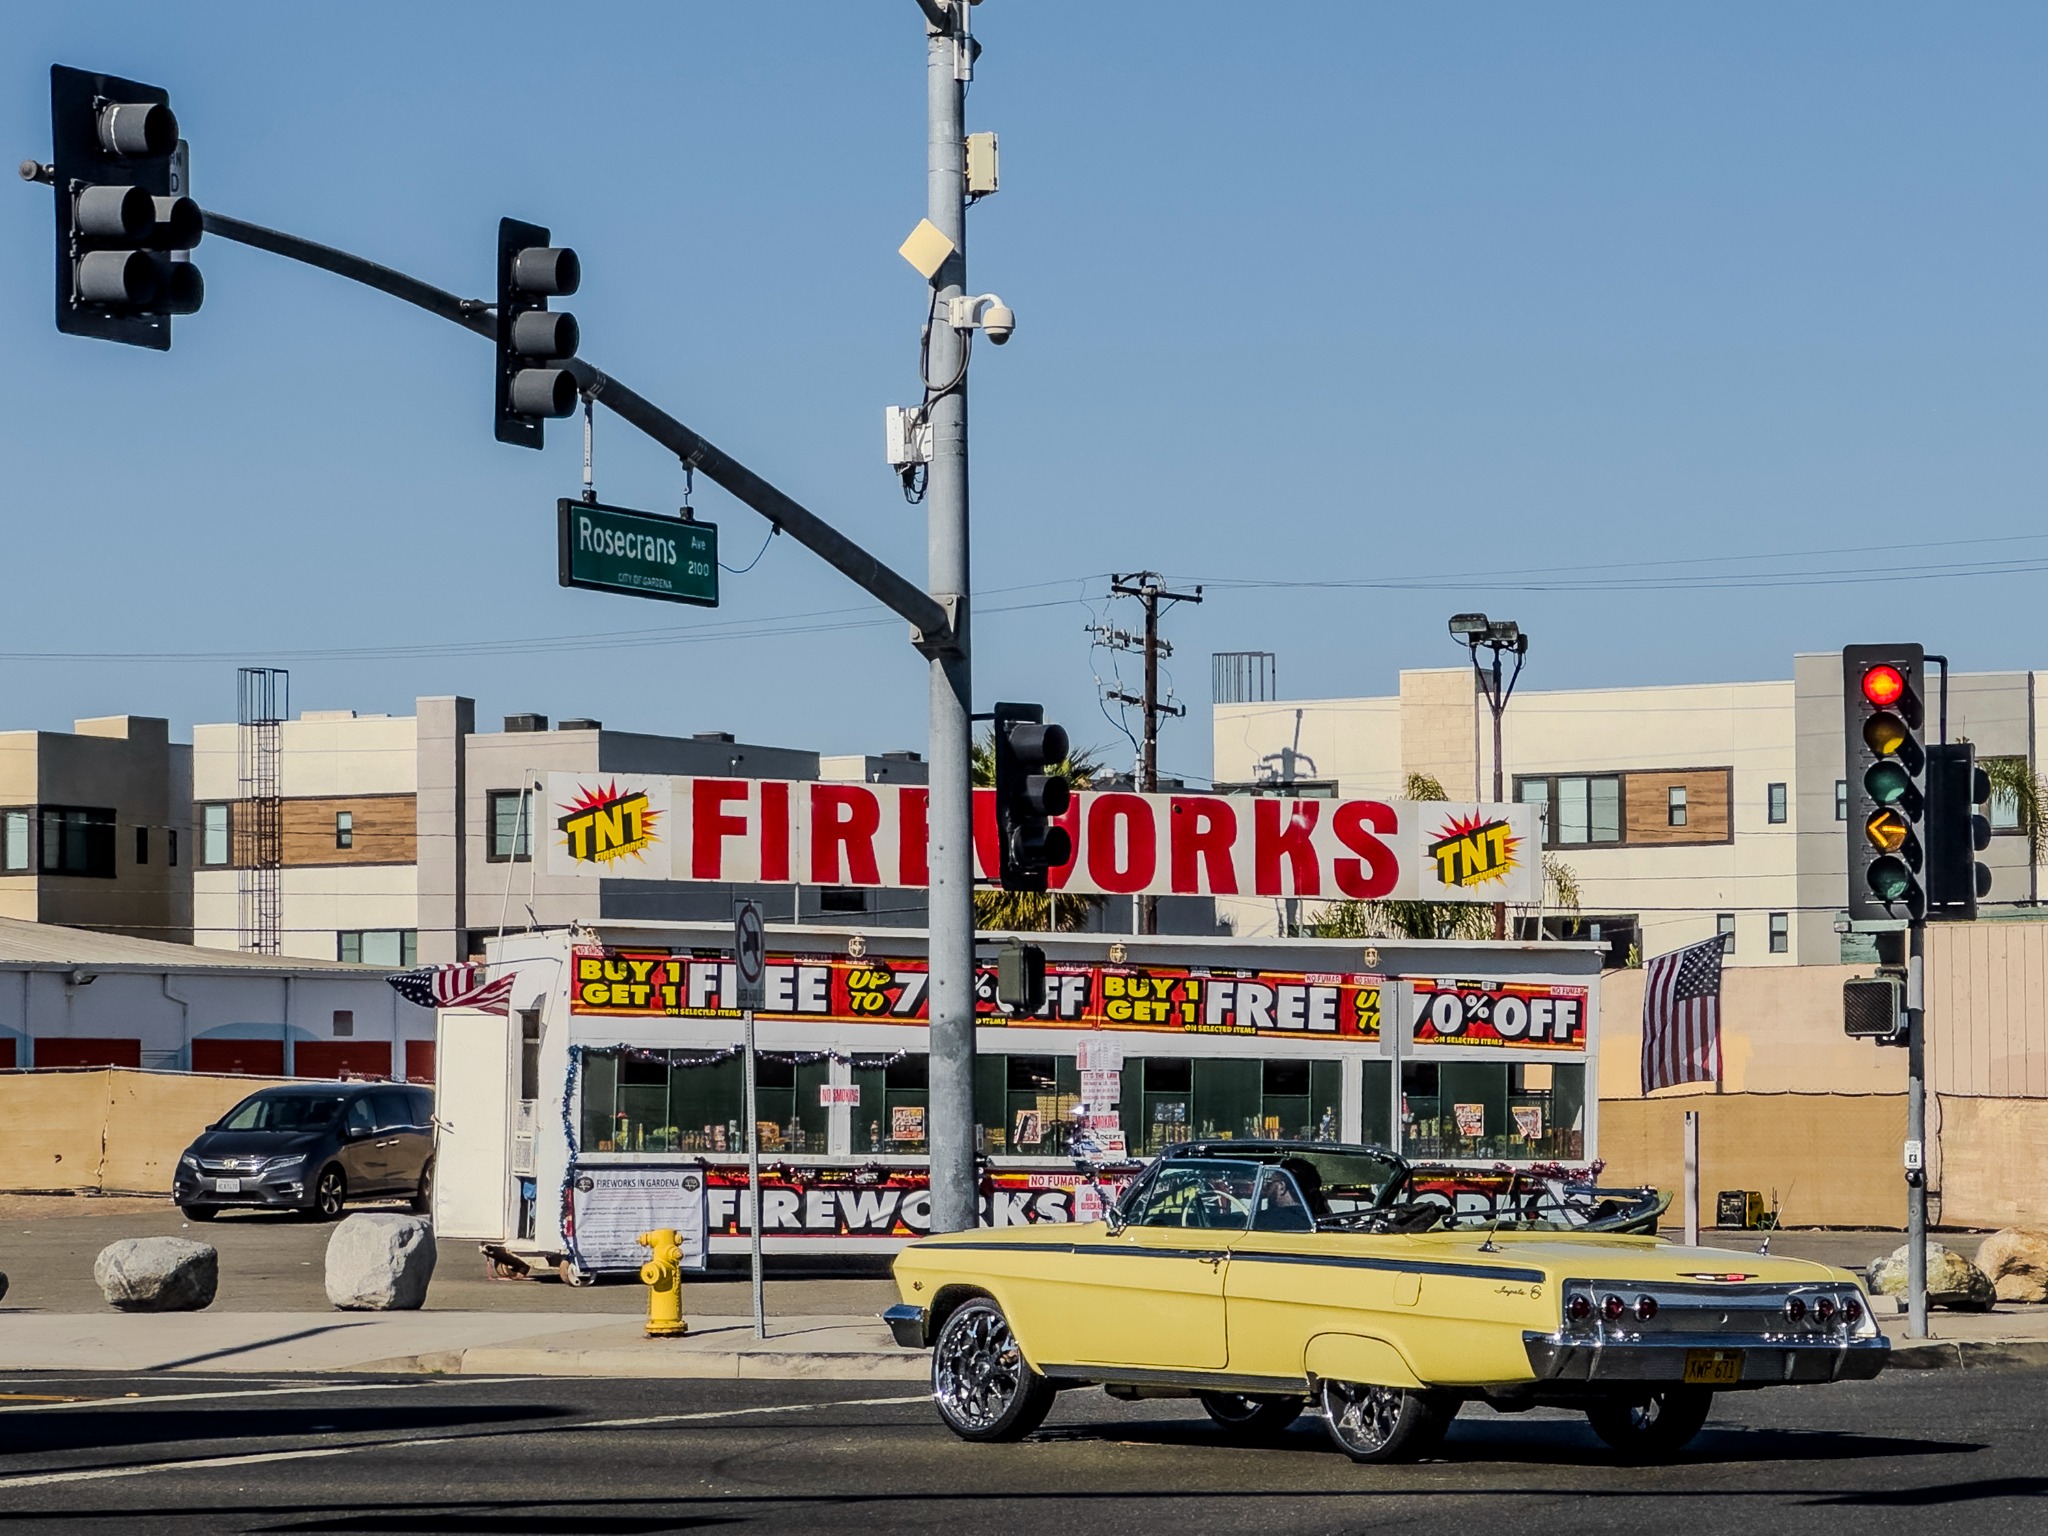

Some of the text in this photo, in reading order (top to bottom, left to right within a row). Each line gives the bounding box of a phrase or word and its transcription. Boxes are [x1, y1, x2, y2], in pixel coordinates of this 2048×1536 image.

[579, 516, 677, 565] Rosecrans
[691, 536, 706, 550] Ave
[687, 561, 710, 577] 2100
[618, 572, 672, 589] CITY OF GARDENA
[566, 794, 649, 860] TNT
[594, 837, 648, 863] FIREWORKS
[1436, 823, 1512, 884] TNT
[1461, 862, 1510, 887] FIREWORKS
[580, 959, 680, 983] BUY 1
[1306, 974, 1340, 984] NO FUMAR
[582, 983, 676, 1006] GET 1
[848, 970, 992, 1012] UP 7%
[996, 976, 1085, 1015] FF
[1104, 976, 1198, 1000] BUY 1
[1552, 987, 1584, 996] NO FUMAR
[850, 991, 885, 1011] TO
[1106, 1000, 1195, 1022] GET 1
[1206, 981, 1338, 1030] FREE
[666, 1007, 742, 1018] ON SELECTED ITEMS
[1493, 996, 1577, 1039] OFF
[1198, 1025, 1233, 1034] SELECTED
[1233, 1026, 1256, 1034] ITEMS
[1446, 1036, 1480, 1045] SELECTED
[1480, 1038, 1503, 1046] ITEMS
[822, 1088, 859, 1103] NO SMOKING
[596, 1178, 680, 1188] FIREWORKS IN GARDENA
[1031, 1175, 1081, 1187] NO FUMAR
[706, 1188, 1067, 1229] FIREWOKS
[1714, 1361, 1735, 1379] 671
